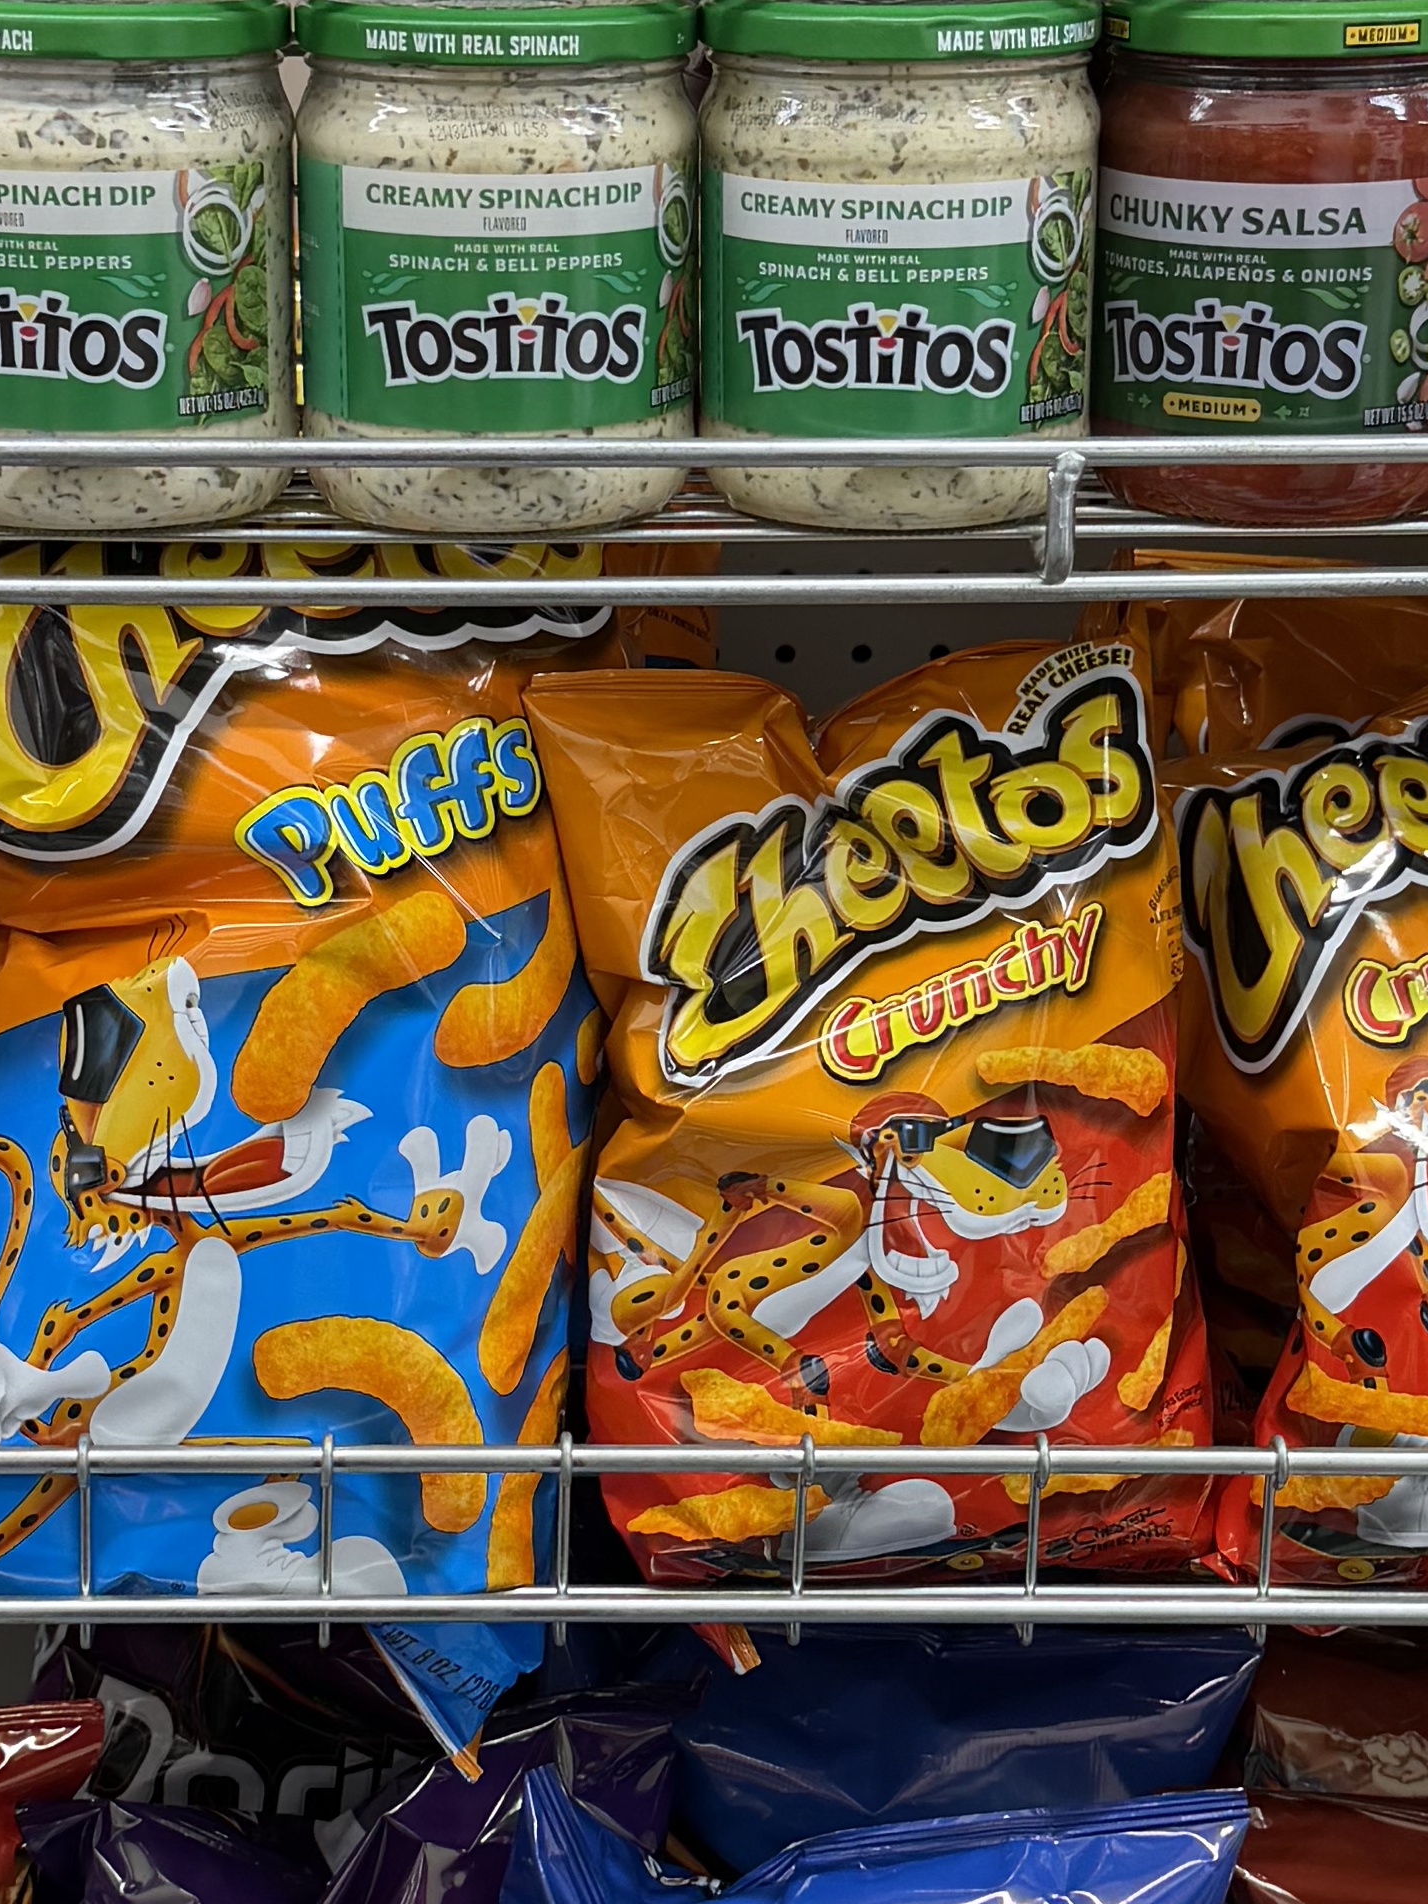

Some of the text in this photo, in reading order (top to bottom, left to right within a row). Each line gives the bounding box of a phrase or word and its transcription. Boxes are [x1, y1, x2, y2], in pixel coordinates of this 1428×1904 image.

[365, 28, 580, 56] MADE WITH REAL SPINACH
[1357, 25, 1408, 44] MEDIUM
[108, 185, 156, 206] DIP
[45, 252, 133, 271] PEPPERS
[235, 716, 542, 908] Puffs
[640, 663, 1159, 1088] Cheetos
[820, 903, 1105, 1083] Crunchy
